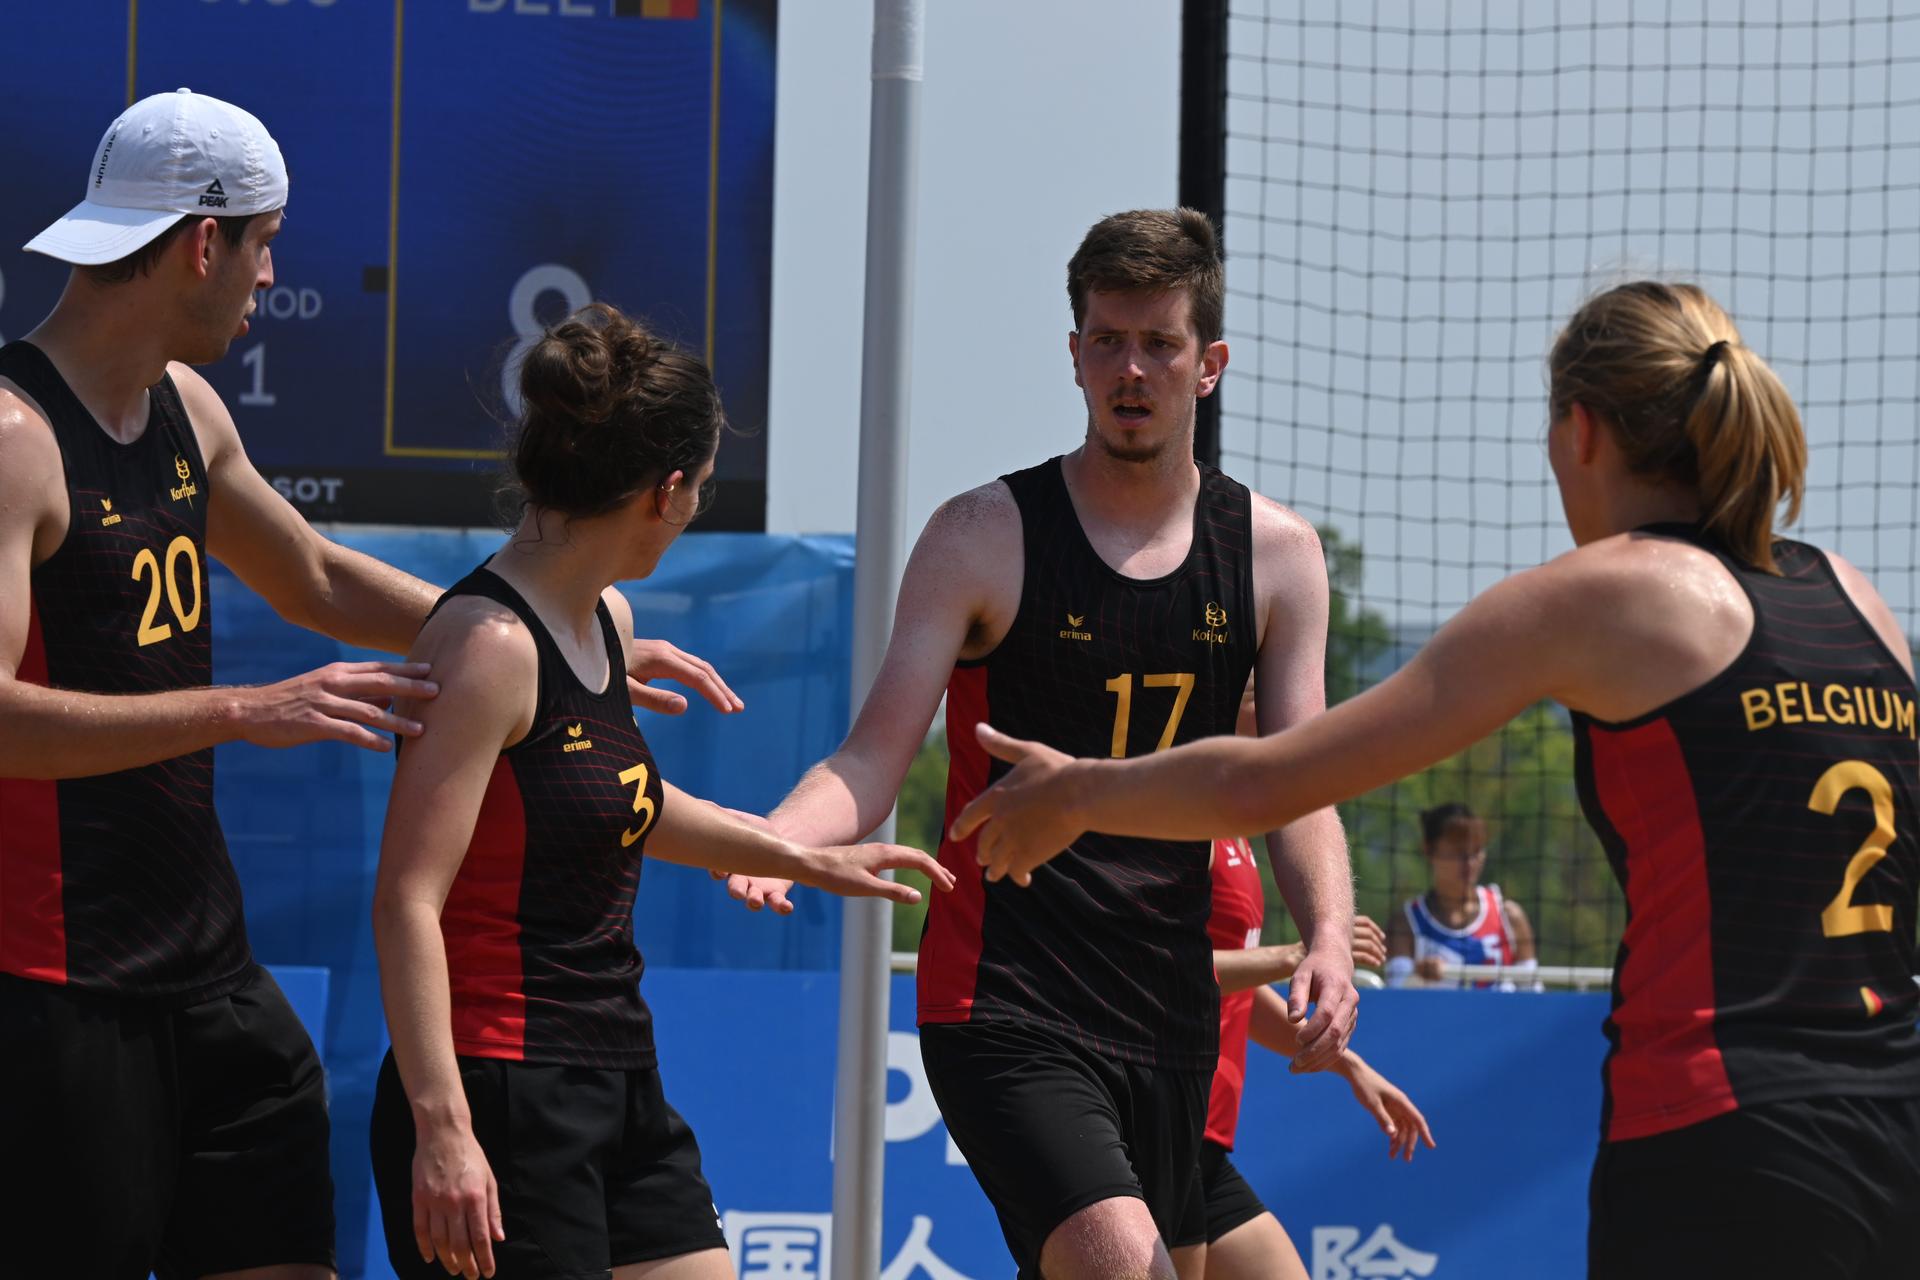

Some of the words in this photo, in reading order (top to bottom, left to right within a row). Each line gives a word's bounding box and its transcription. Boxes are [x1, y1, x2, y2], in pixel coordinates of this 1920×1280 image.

[199, 195, 229, 208] PEAK
[258, 286, 322, 319] IOD
[239, 343, 276, 406] 1
[272, 476, 343, 503] SOT
[131, 535, 201, 647] 20
[1059, 629, 1092, 641] erima
[1105, 672, 1196, 758] 17
[1740, 681, 1916, 740] BELGIUM
[563, 739, 593, 753] erima
[618, 763, 655, 848] 3
[1807, 759, 1897, 938] 2
